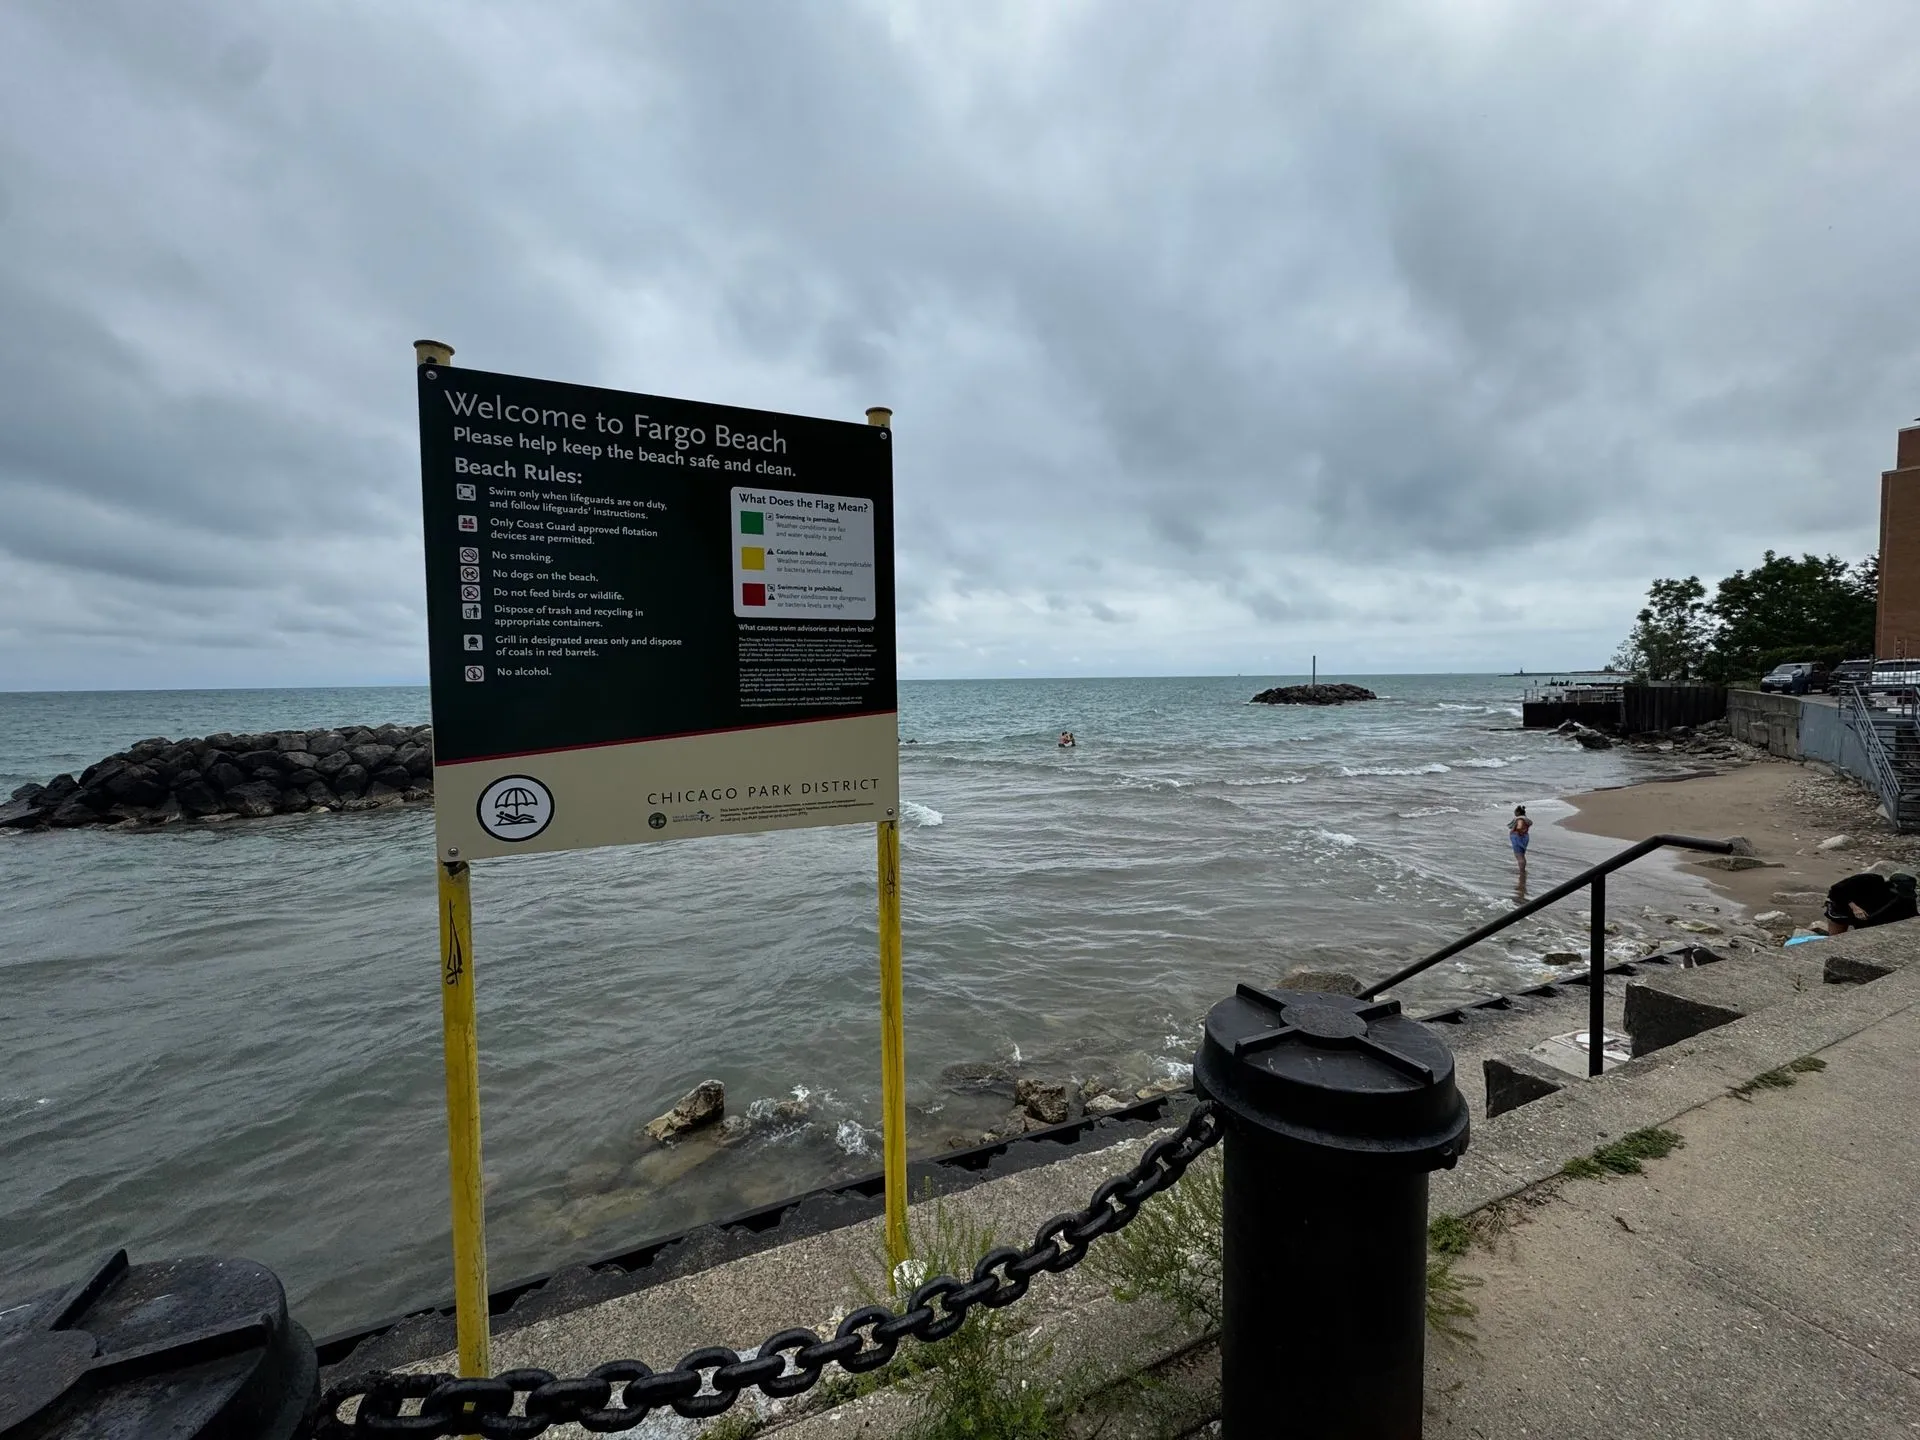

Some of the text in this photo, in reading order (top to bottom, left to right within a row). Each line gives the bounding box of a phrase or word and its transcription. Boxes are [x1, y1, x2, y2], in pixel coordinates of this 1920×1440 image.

[446, 390, 786, 454] Welcome to Fargo Beach
[454, 426, 796, 477] Please help keep the beach safe and clean.
[455, 457, 582, 484] Beach Rules:
[489, 487, 516, 498] Swim
[519, 490, 540, 504] only
[542, 491, 568, 501] when
[570, 493, 615, 508] lifeguards
[646, 500, 667, 511] duty,
[739, 493, 868, 513] What Does the Flag Mean?
[510, 501, 540, 511] follow
[593, 508, 648, 519] instructions.
[490, 518, 658, 537] Only Coast Guard approved flotation
[490, 531, 595, 545] devices are permitted.
[492, 551, 554, 564] No smoking.
[493, 569, 508, 578] No
[510, 570, 534, 581] dogs
[551, 571, 567, 581] the
[569, 572, 599, 582] beach.
[494, 588, 508, 596] Do
[529, 588, 550, 598] feed
[552, 589, 576, 599] birds
[590, 591, 624, 600] wildlife.
[494, 605, 644, 619] Dispose of trash and recycling in
[494, 618, 603, 628] appropriate containers.
[495, 636, 516, 644] Grill
[519, 636, 528, 644] in
[531, 636, 582, 647] designated
[610, 636, 629, 647] only
[631, 637, 647, 645] and
[649, 637, 682, 647] dispose
[496, 648, 599, 656] of coals in red barrels.
[497, 667, 552, 676] No alcohol.
[647, 778, 880, 805] CHICAGO PARK DISTRICT
